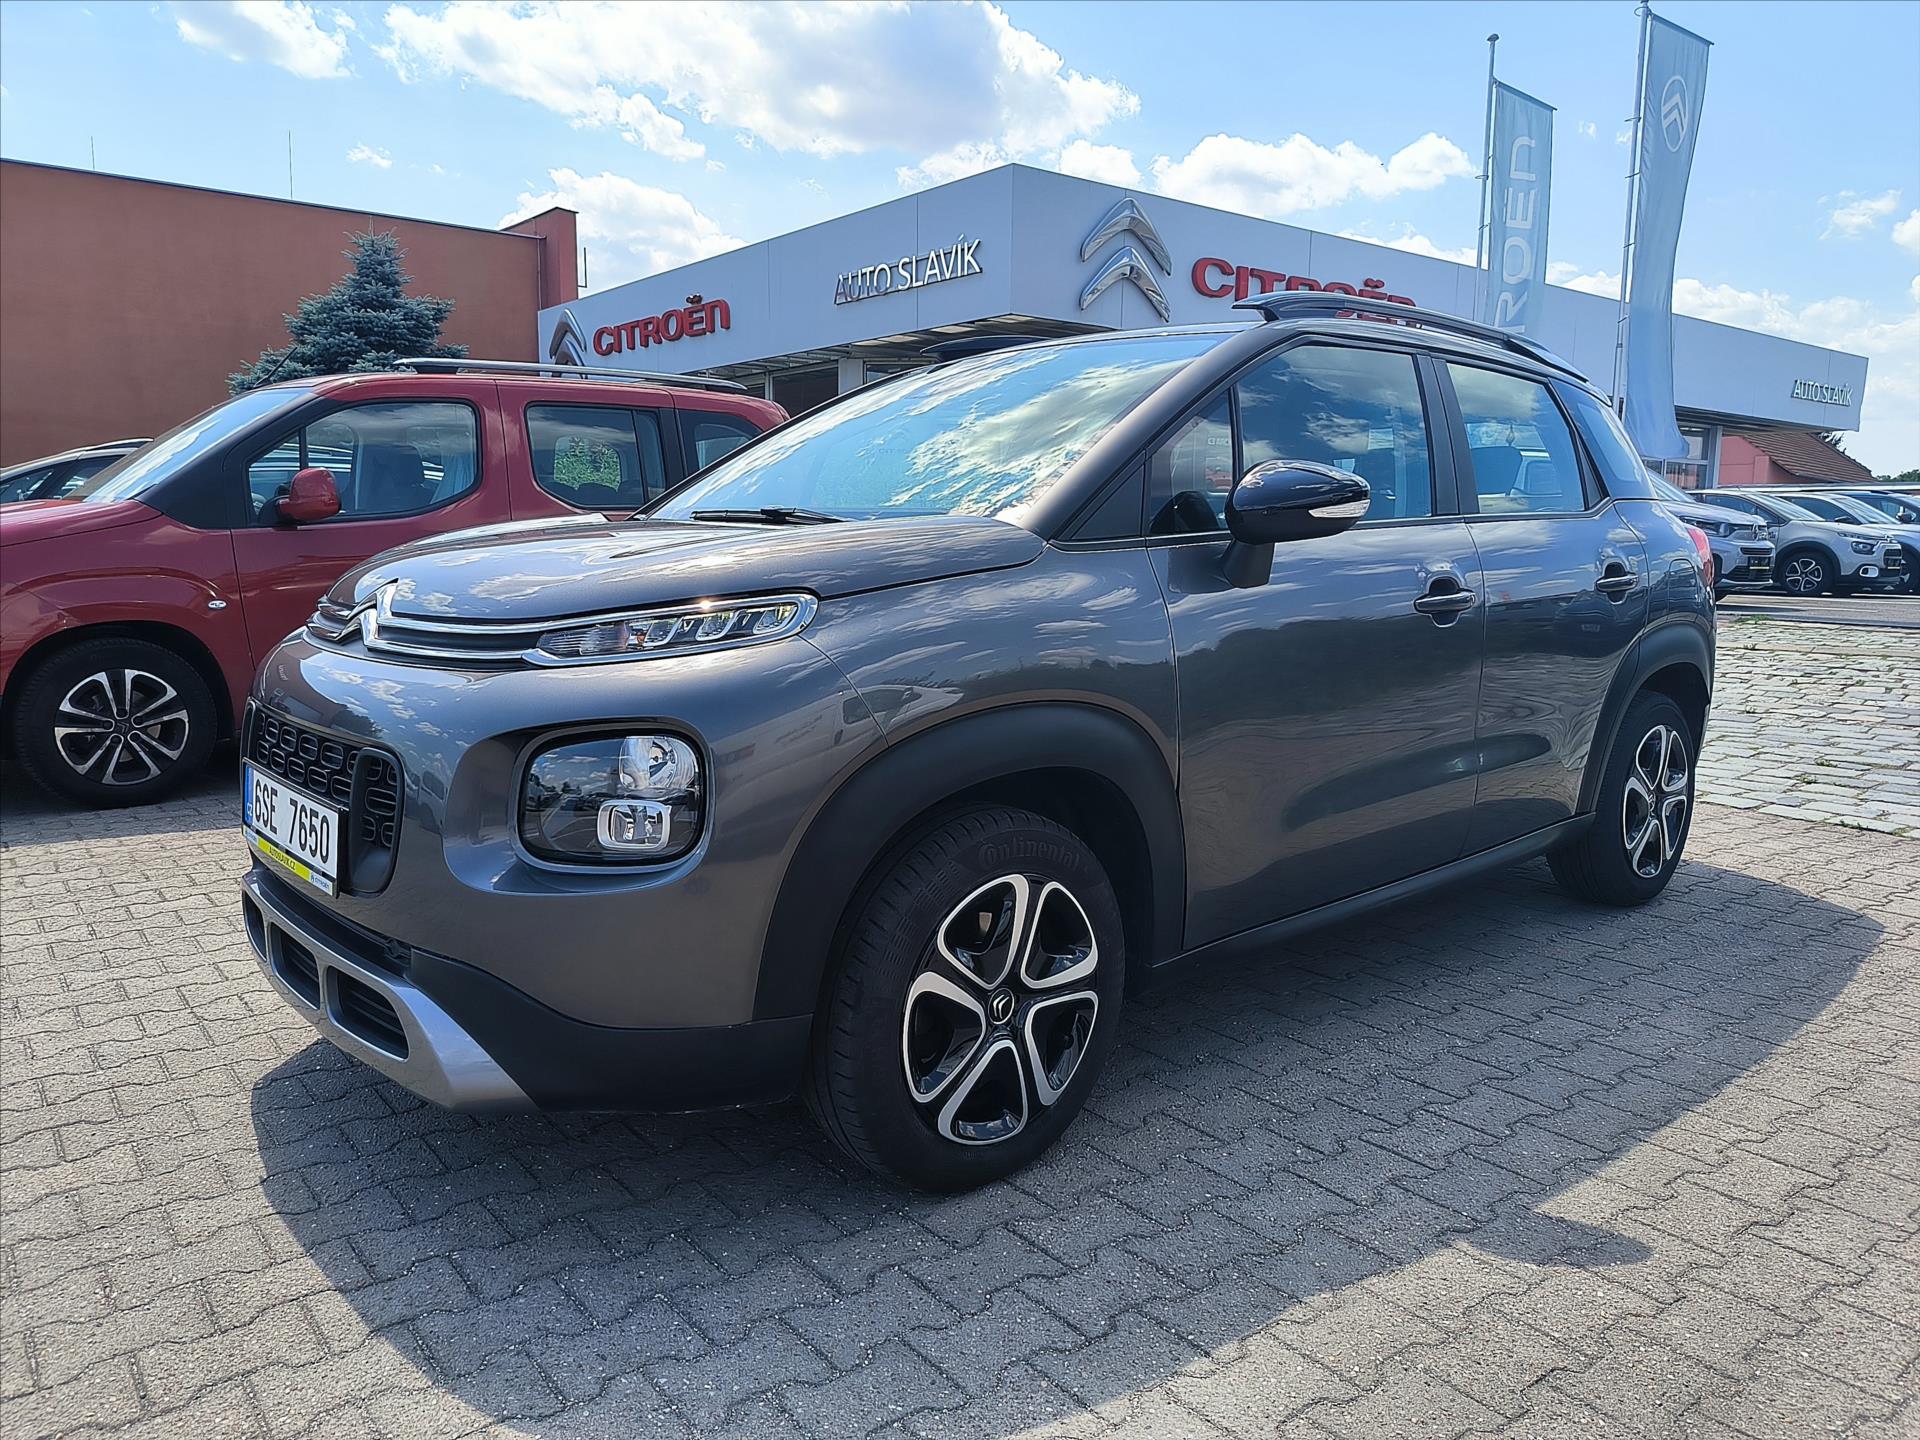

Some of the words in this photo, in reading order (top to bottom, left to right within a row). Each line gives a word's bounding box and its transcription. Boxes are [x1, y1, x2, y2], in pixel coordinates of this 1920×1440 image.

[833, 263, 892, 305] AUTO
[898, 233, 982, 290] SLAVÍK
[1793, 379, 1821, 401] AUTO
[1822, 383, 1854, 406] SLAVÍK
[255, 778, 278, 835] 6SE
[288, 797, 331, 864] 7650
